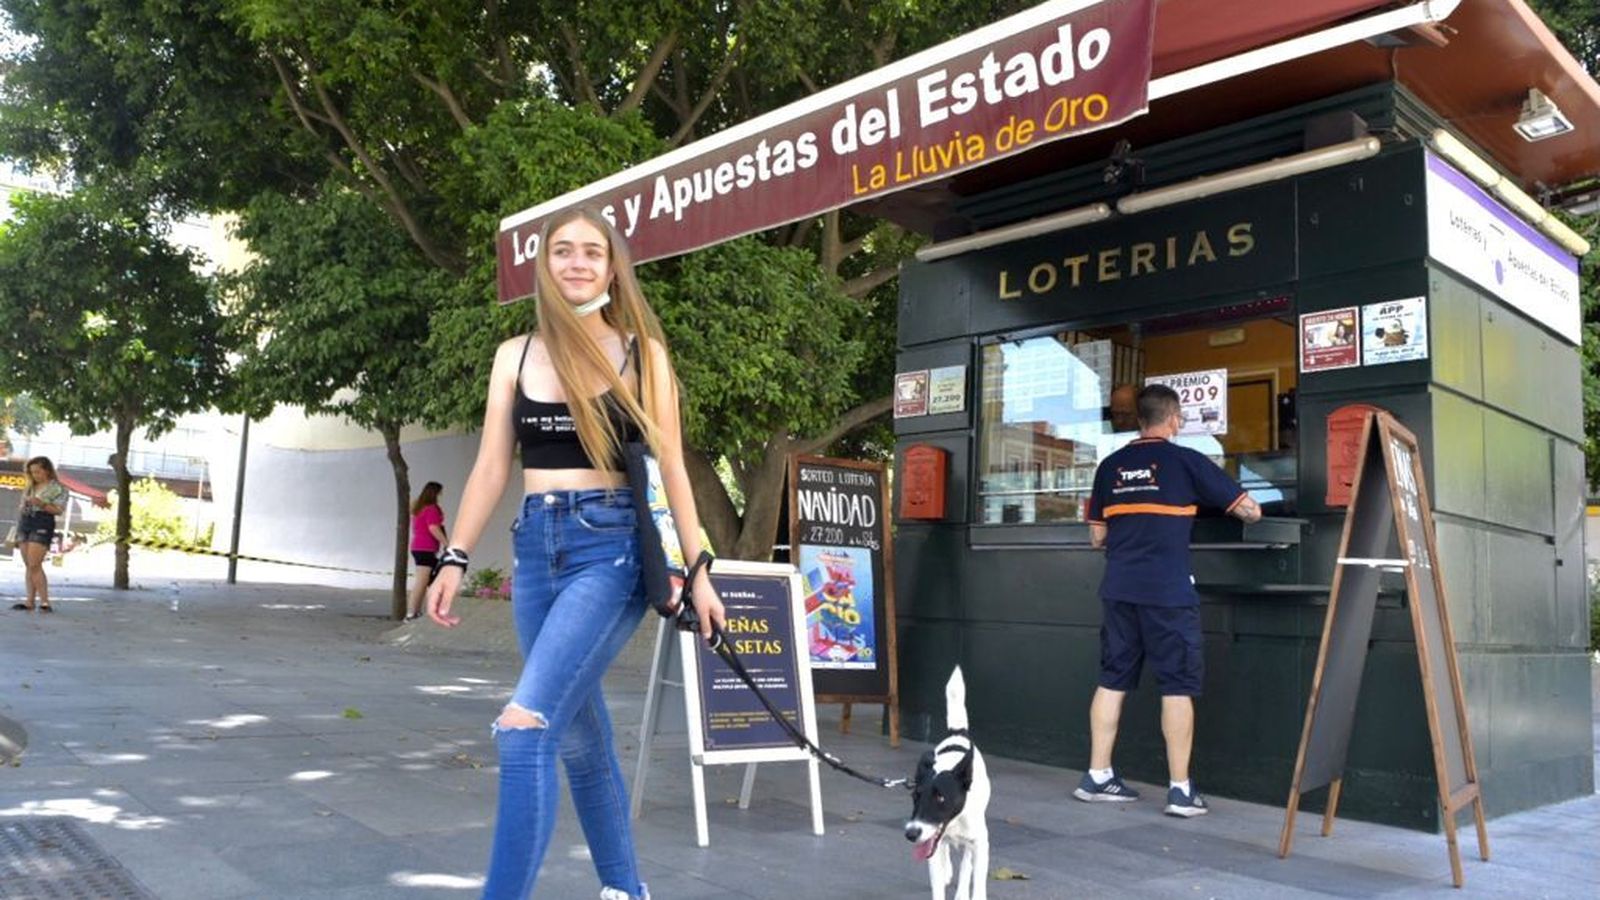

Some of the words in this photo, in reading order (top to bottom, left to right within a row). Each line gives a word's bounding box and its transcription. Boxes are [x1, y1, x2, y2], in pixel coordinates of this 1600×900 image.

[624, 193, 641, 237] y
[649, 131, 819, 222] Apuestas
[831, 87, 901, 156] del
[916, 23, 1112, 129] Estado
[852, 164, 886, 195] La
[895, 130, 986, 183] Lluvia
[995, 114, 1035, 153] de
[1044, 93, 1110, 133] Oro
[999, 222, 1256, 301] LOTERIAS
[1170, 375, 1210, 387] PREMIO
[1181, 386, 1218, 402] 209
[800, 468, 834, 484] SORTEO
[1120, 469, 1151, 481] TIPSA
[735, 639, 783, 655] SETAS
